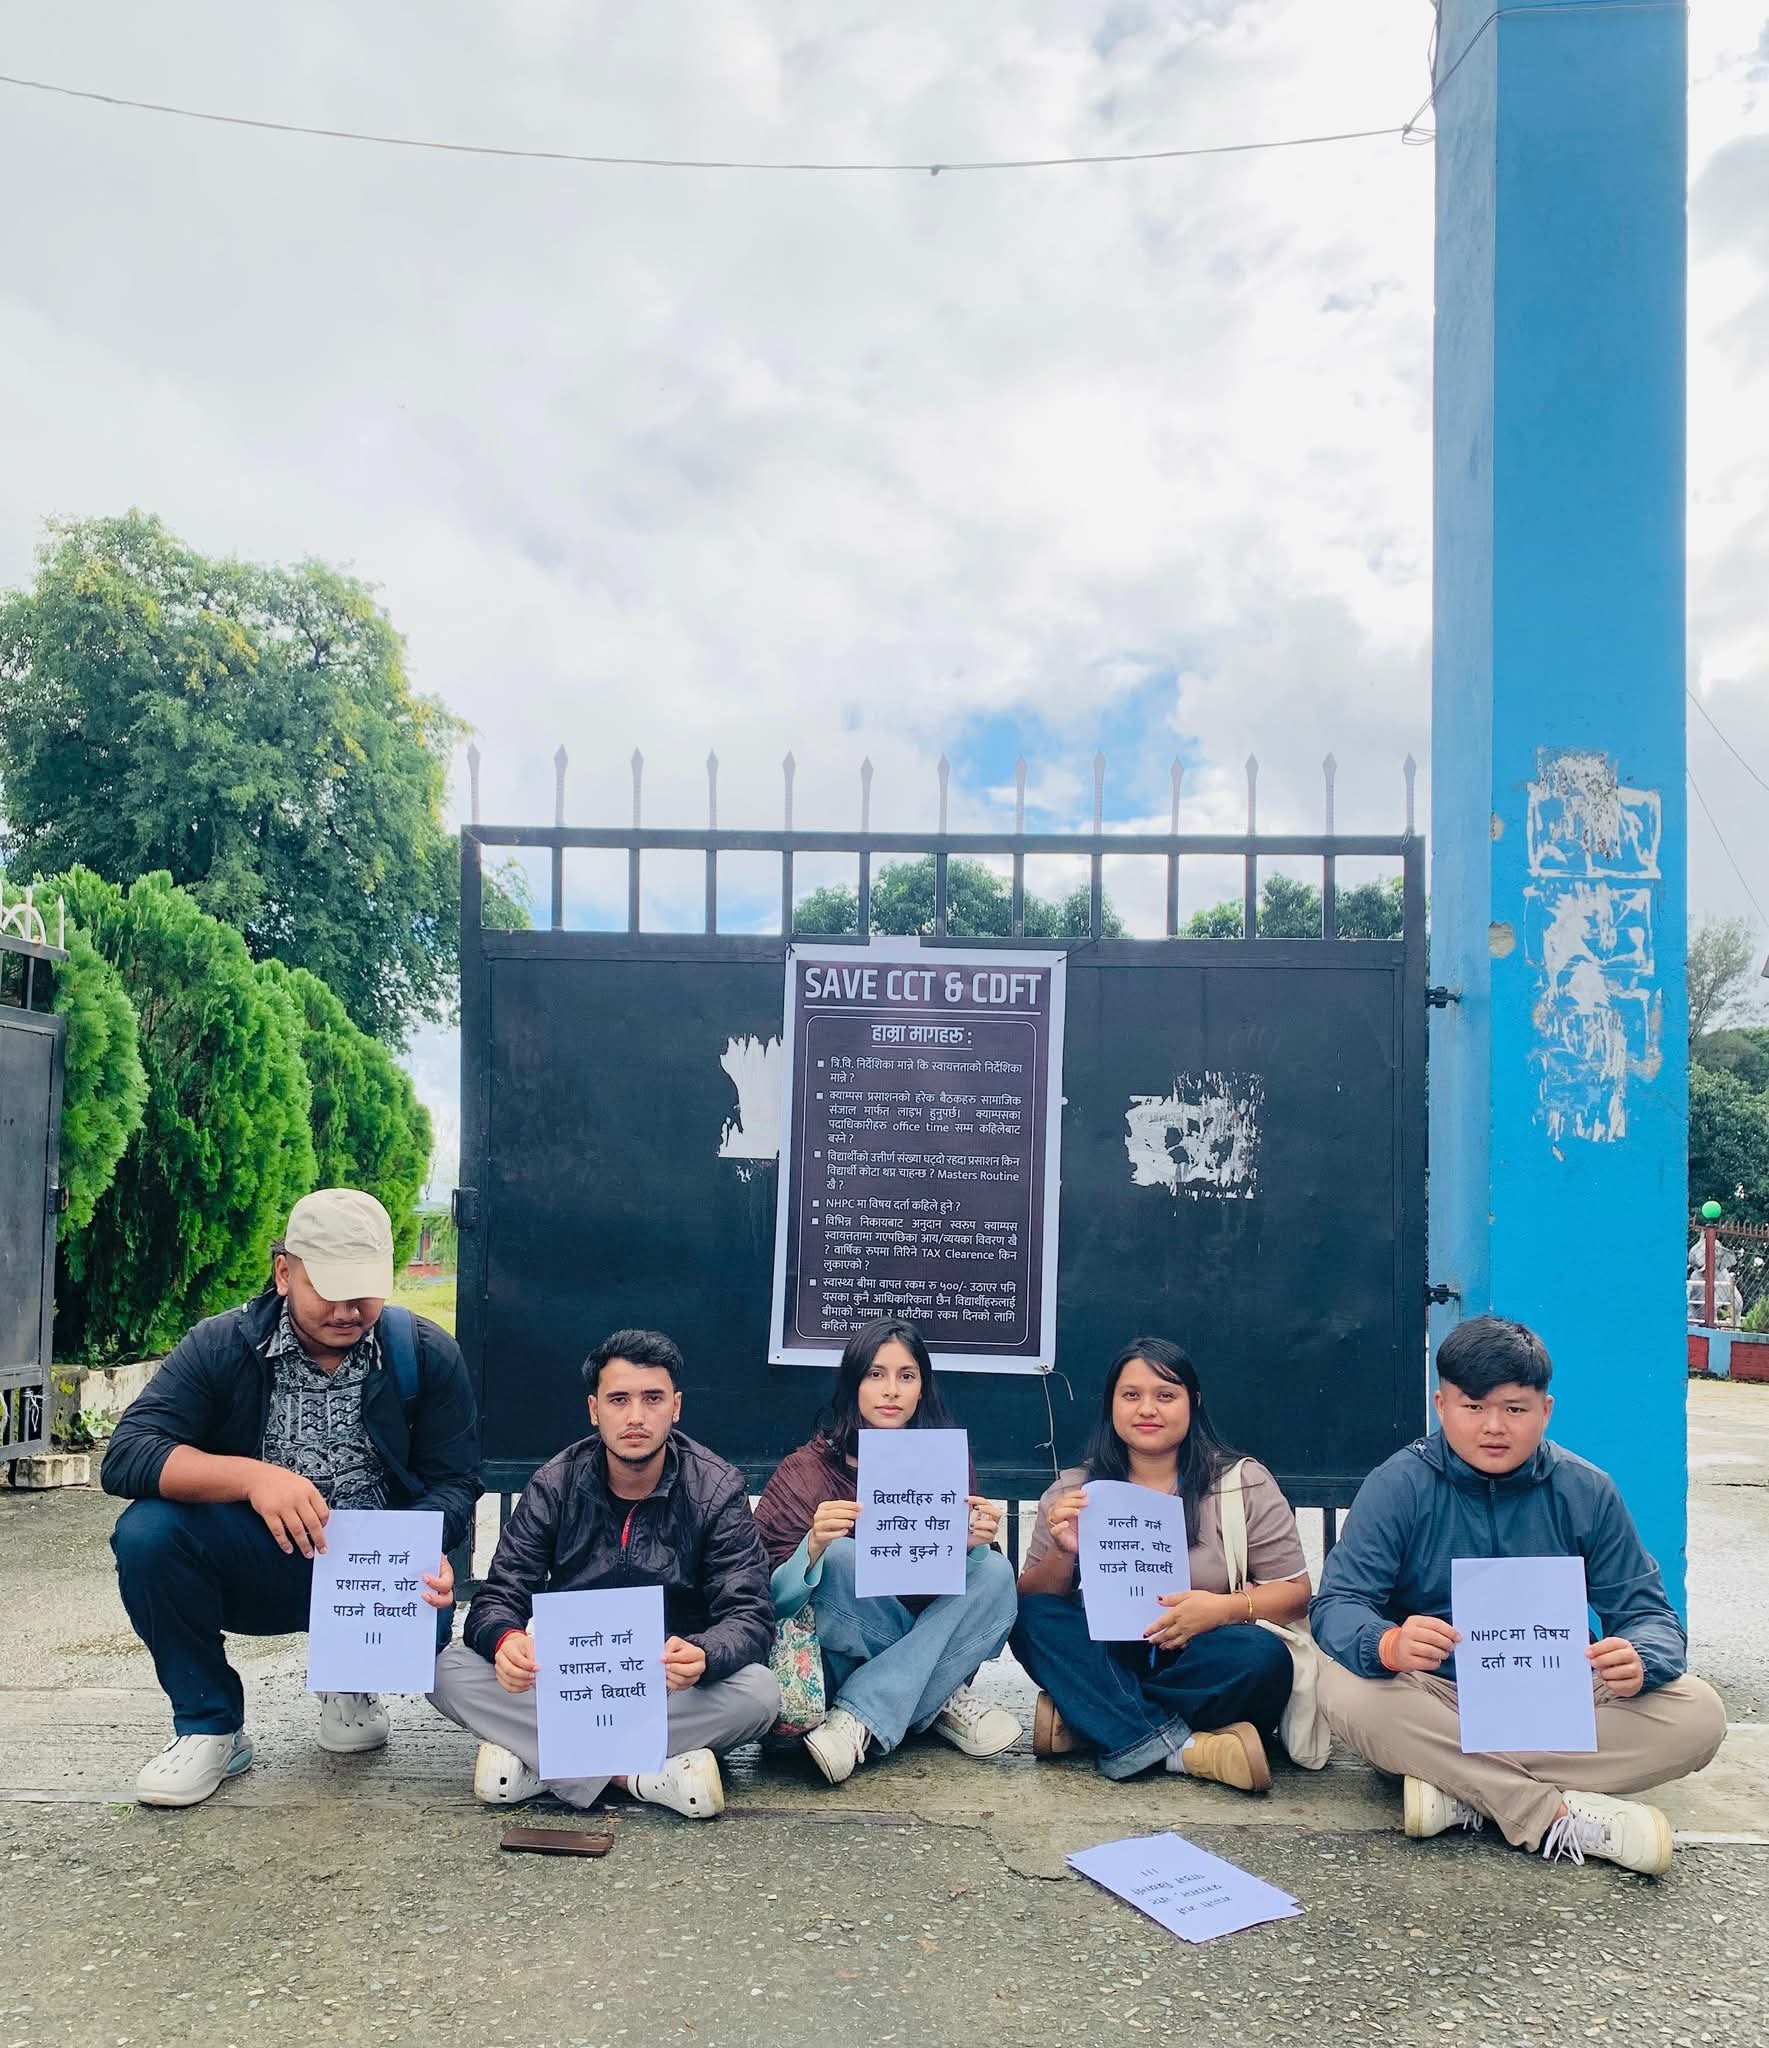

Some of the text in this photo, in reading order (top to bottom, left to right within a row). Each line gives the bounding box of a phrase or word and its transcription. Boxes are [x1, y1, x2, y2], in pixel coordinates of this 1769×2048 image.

[804, 968, 1042, 1005] SAVE CCT & CDFT
[871, 1024, 906, 1042] हाम्रा
[856, 1057, 894, 1069] निर्देशिका
[917, 1060, 928, 1070] कि
[932, 1061, 981, 1072] स्वायत्तताको
[984, 1060, 1022, 1073] निर्देशिका
[850, 1074, 854, 1082] ?
[829, 1090, 863, 1100] क्याम्पस
[915, 1091, 936, 1103] हरेक
[940, 1091, 976, 1104] बैठकहरु
[980, 1094, 1022, 1105] सामाजिक
[829, 1103, 856, 1114] संजाल
[864, 1104, 889, 1115] मार्फत
[897, 1107, 922, 1117] लाइभ
[976, 1110, 1021, 1120] क्याम्पसका
[829, 1118, 1021, 1134] पदाधिकारीहरु office time सम्म कहिलेबाट
[828, 1132, 853, 1143] बस्ने ?
[828, 1149, 868, 1161] विद्यार्थीको
[871, 1150, 895, 1162] उत्तीर्ण
[897, 1152, 921, 1163] संख्या
[1001, 1155, 1020, 1166] किन
[827, 1164, 856, 1176] विद्यार्थी
[859, 1165, 880, 1176] कोटा
[899, 1169, 926, 1178] चाहन्छ
[930, 1169, 934, 1178] ?
[938, 1170, 977, 1179] Masters
[980, 1171, 1019, 1181] Routine
[826, 1178, 843, 1190] खै ?
[826, 1198, 961, 1214] NHPC मा विषय दर्ता कहिले हुने ?
[825, 1214, 1018, 1231] विभिन्न निकायबाट अनुदान स्वरुप क्याम्पस
[824, 1231, 872, 1240] स्वायत्ततामा
[875, 1231, 917, 1242] गएपछिका
[976, 1233, 1005, 1245] विवरण
[1008, 1234, 1017, 1245] खै
[825, 1243, 1017, 1260] ? वार्षिक रुपमा तिरिने TAX Clearence किन
[824, 1258, 869, 1272] लुकाएको ?
[823, 1278, 854, 1287] स्वास्थ्य
[857, 1276, 876, 1288] बीमा
[904, 1280, 925, 1289] रकम
[928, 1281, 937, 1290] रु
[970, 1283, 997, 1292] उठाएर
[1000, 1281, 1016, 1292] पनि
[822, 1293, 849, 1301] यसका
[853, 1290, 869, 1305] कुनै
[873, 1292, 932, 1304] आधिकारिकता
[936, 1293, 951, 1305] छैन
[822, 1304, 853, 1316] बीमाको
[857, 1308, 883, 1317] नाममा
[887, 1309, 892, 1318] र
[937, 1310, 958, 1320] रकम
[963, 1309, 989, 1320] दिनको
[994, 1310, 1015, 1322] लागि
[821, 1319, 848, 1331] कहिले
[873, 1489, 956, 1505] विद्यार्थीहरु को
[876, 1516, 950, 1531] आखिर पीडा
[1108, 1516, 1162, 1530] गल्ती गर्ने
[870, 1543, 953, 1562] कस्ले बुझ्ने ?
[1152, 1540, 1172, 1553] चोट
[348, 1550, 410, 1565] गल्ती गर्ने
[1099, 1560, 1173, 1574] पाउने विद्यार्थी
[394, 1578, 418, 1591] चोट
[333, 1602, 418, 1617] पाउने विद्यार्थी
[569, 1629, 633, 1648] गल्ती गर्ने
[1534, 1625, 1570, 1641] विषय
[620, 1657, 644, 1671] चोट
[1481, 1653, 1505, 1669] दर्ता
[1513, 1656, 1532, 1668] गर
[560, 1682, 646, 1701] पाउने विद्यार्थी
